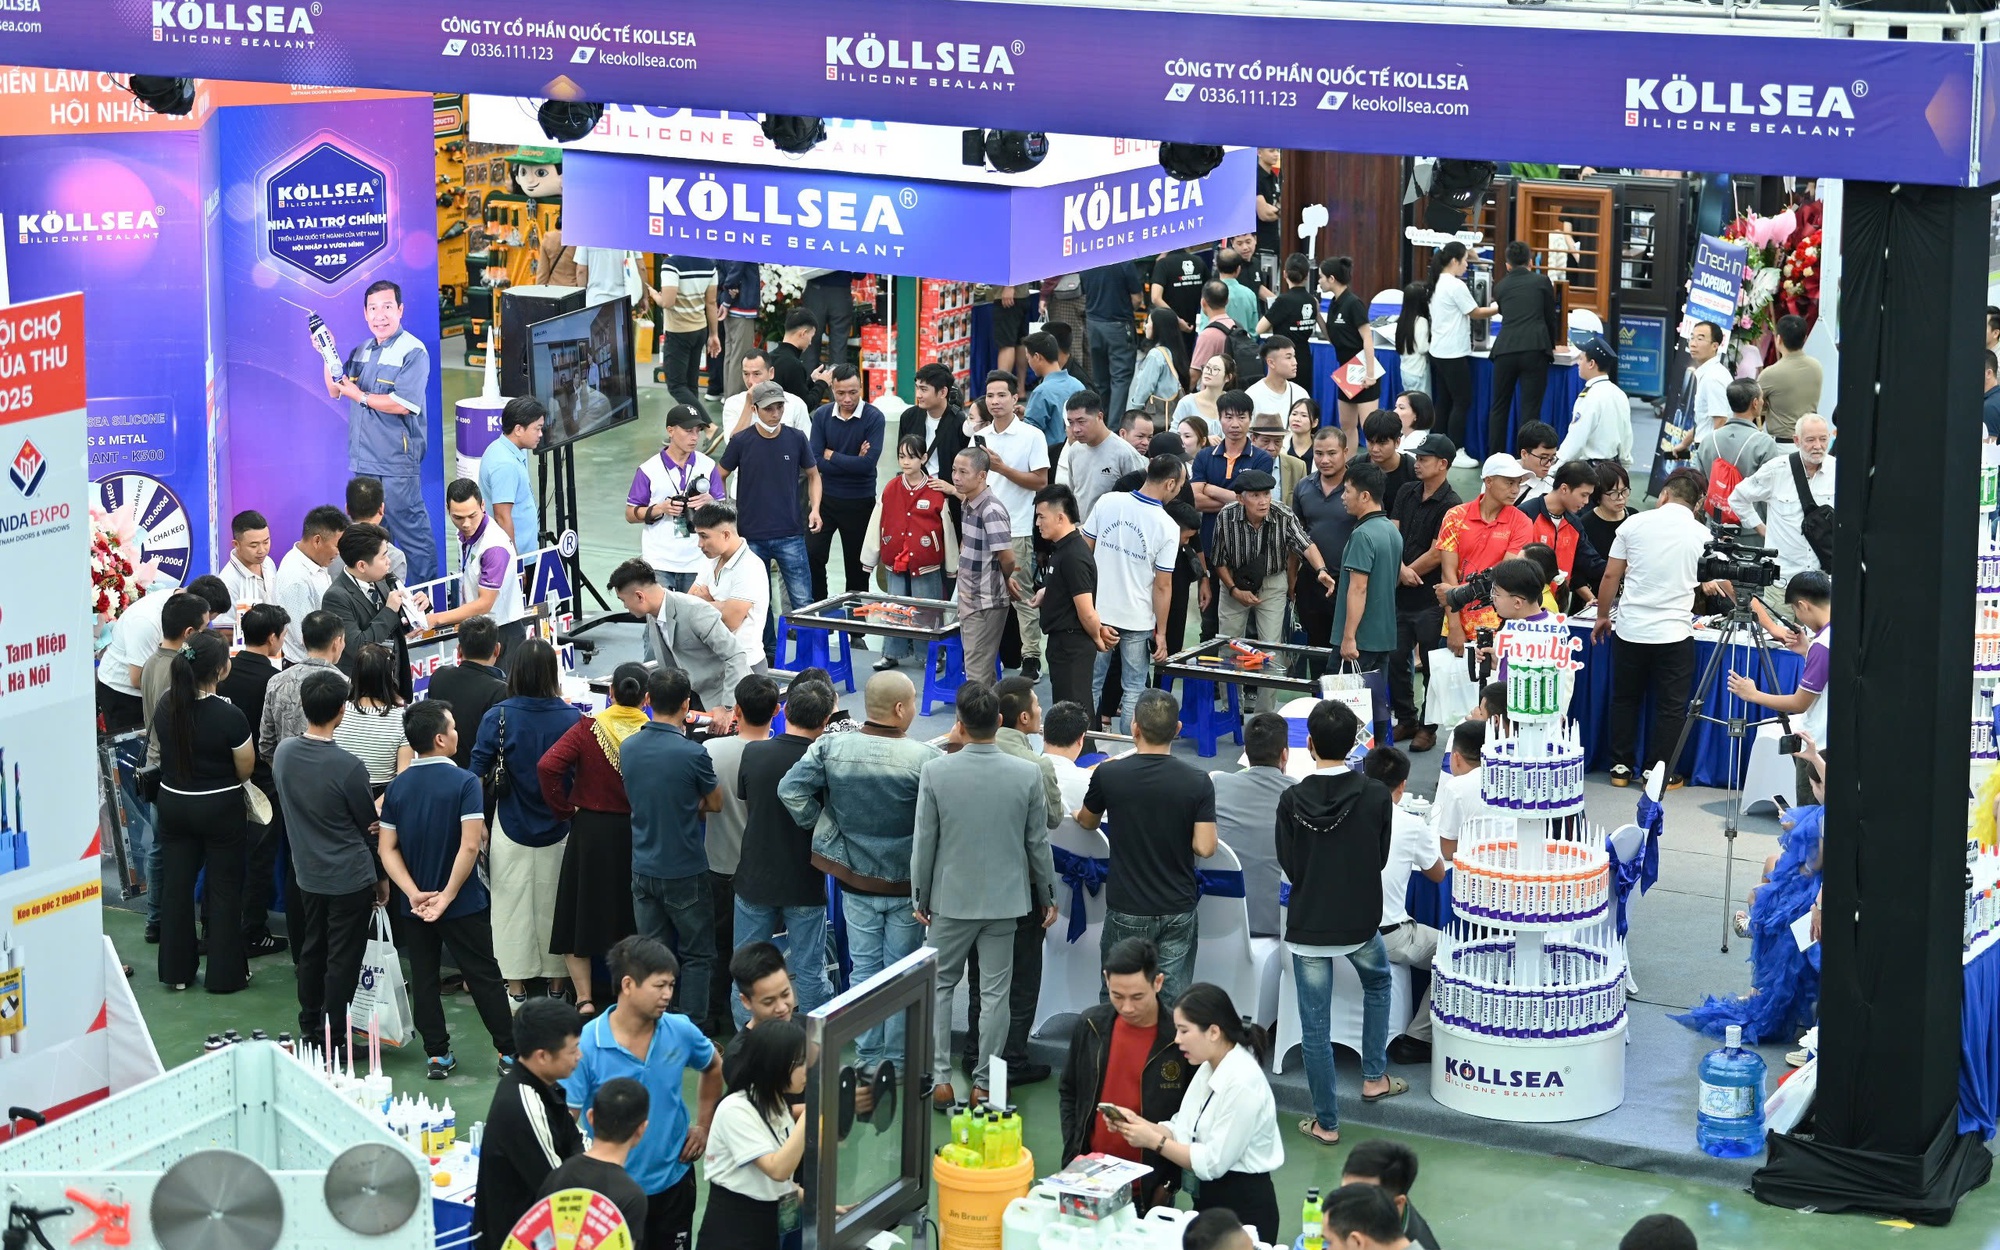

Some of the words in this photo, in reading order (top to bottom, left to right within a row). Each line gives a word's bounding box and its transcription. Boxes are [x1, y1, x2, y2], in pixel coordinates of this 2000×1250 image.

[0, 20, 42, 33] ea.com
[152, 28, 232, 46] SILICONE
[241, 37, 315, 50] SEALANT
[441, 16, 481, 35] CÔNG
[483, 21, 501, 36] TY
[503, 17, 524, 37] CỔ
[527, 20, 567, 40] PHẦN
[569, 23, 611, 43] QUỐC
[613, 25, 630, 44] TẾ
[633, 30, 697, 47] KOLLSEA
[471, 43, 554, 61] 0336.111.123
[600, 49, 697, 70] keokollsea.com
[826, 65, 918, 86] SILICONE
[929, 78, 1016, 92] SEALANT
[1164, 58, 1211, 79] CÔNG
[1214, 64, 1235, 80] TY
[1239, 60, 1262, 81] CỔ
[1266, 62, 1313, 83] PHẦN
[1316, 64, 1367, 87] QUỐC
[1369, 66, 1390, 88] TẾ
[1393, 71, 1469, 92] KOLLSEA
[51, 99, 90, 126] HỘI
[1199, 87, 1298, 107] 0336.111.123
[1352, 94, 1469, 116] keokollsea.com
[1625, 110, 1736, 132] SILICONE
[1750, 123, 1855, 137] SEALANT
[268, 217, 295, 231] NHÀ
[297, 215, 318, 229] TÀI
[320, 214, 346, 229] TRỢ
[348, 212, 387, 226] CHÍNH
[19, 233, 88, 244] SILICONE
[96, 232, 160, 241] SEALANT
[649, 216, 772, 246] SILICONE
[787, 236, 905, 258] SEALANT
[1062, 231, 1135, 257] SILICONE
[1142, 216, 1204, 239] SEALANT
[314, 253, 347, 266] 2025
[1698, 244, 1731, 273] Check
[1732, 259, 1742, 277] in
[1701, 271, 1732, 294] TOPEURO
[20, 310, 62, 342] CHỢ
[30, 345, 68, 373] THU
[98, 436, 106, 446] &
[109, 434, 148, 446] METAL
[132, 449, 165, 463] K500
[142, 494, 170, 530] 100.000đ
[153, 530, 170, 543] CHAI
[170, 523, 186, 535] KEO
[1114, 545, 1131, 556] QUNG
[6, 641, 33, 665] Tam
[36, 632, 67, 657] Hiệp
[8, 670, 26, 693] Hà
[29, 662, 51, 688] Nội
[1445, 1073, 1496, 1095] SILICONE
[948, 1210, 960, 1220] Jin
[961, 1212, 987, 1222] Braun
